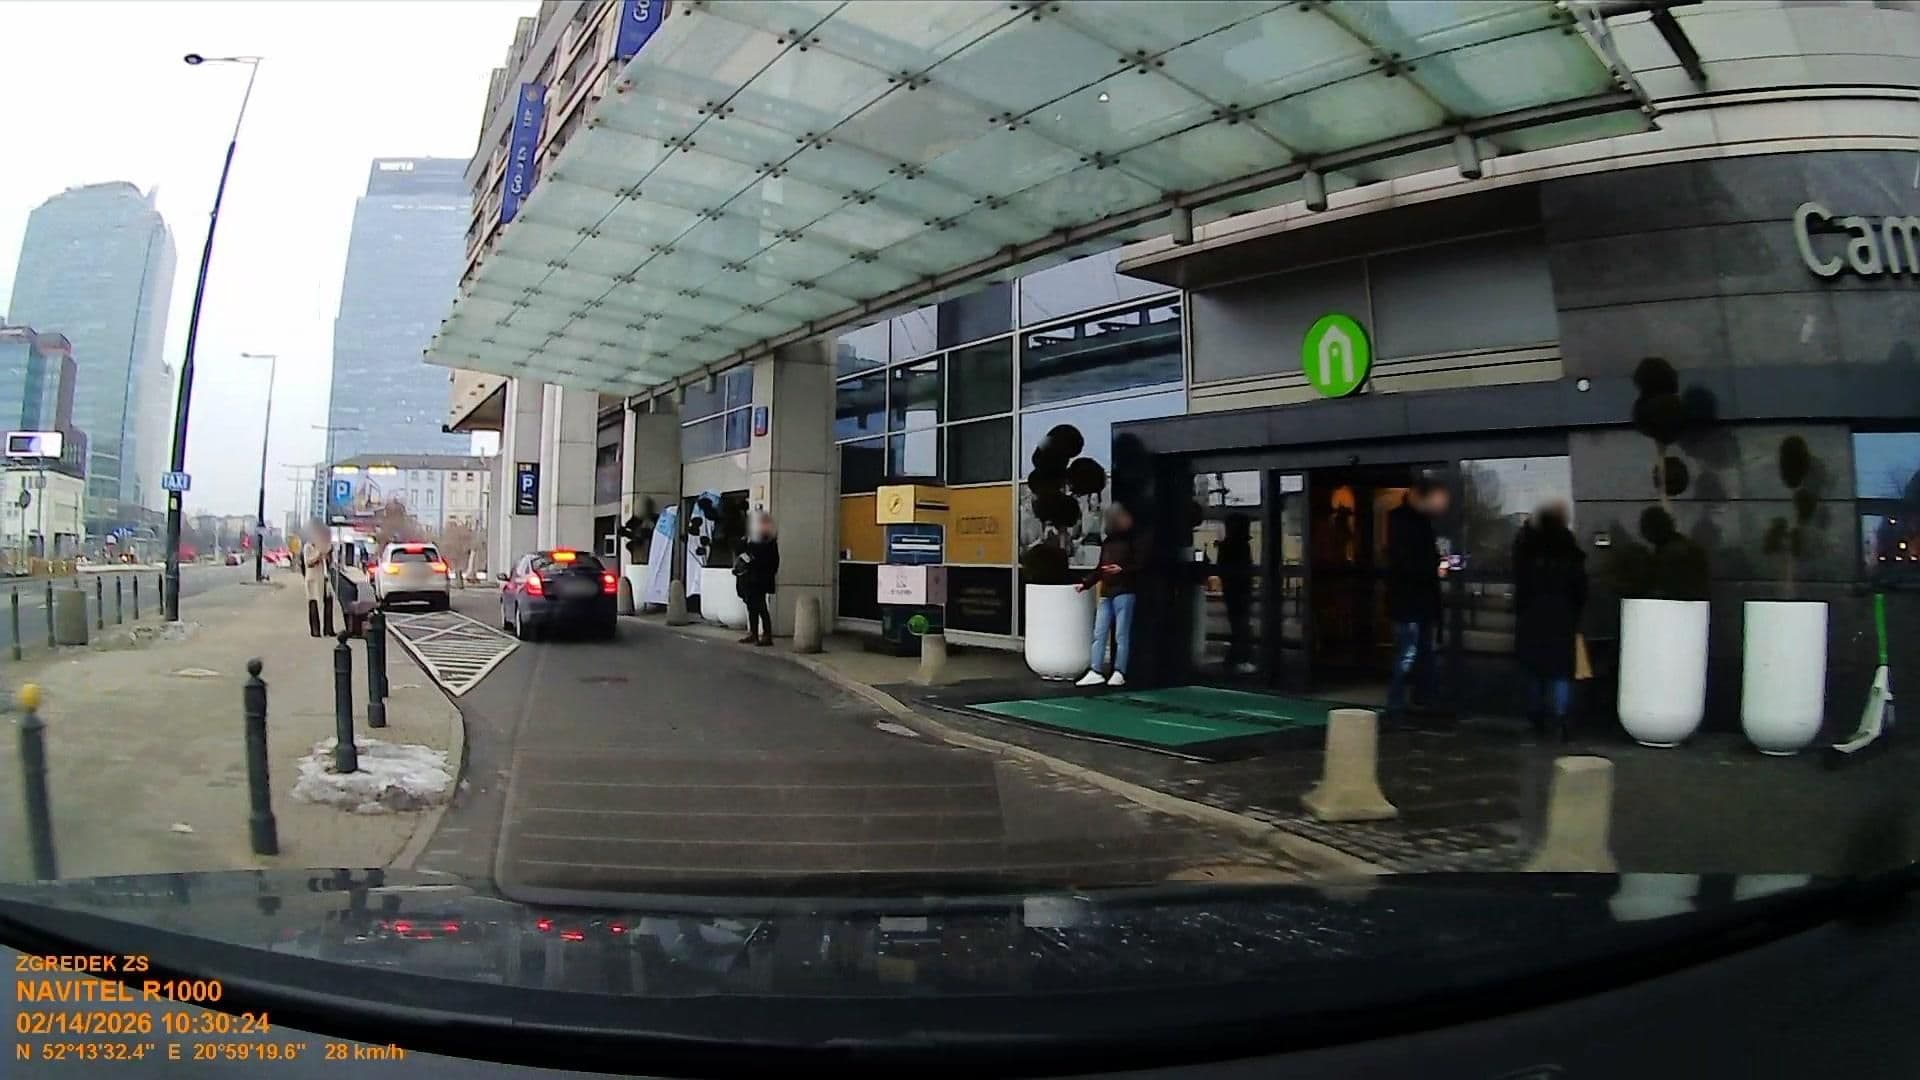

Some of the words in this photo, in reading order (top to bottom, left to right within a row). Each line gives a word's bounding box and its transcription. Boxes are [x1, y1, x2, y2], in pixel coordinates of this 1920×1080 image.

[163, 474, 189, 489] TAXI
[522, 476, 534, 492] P
[337, 481, 349, 499] P
